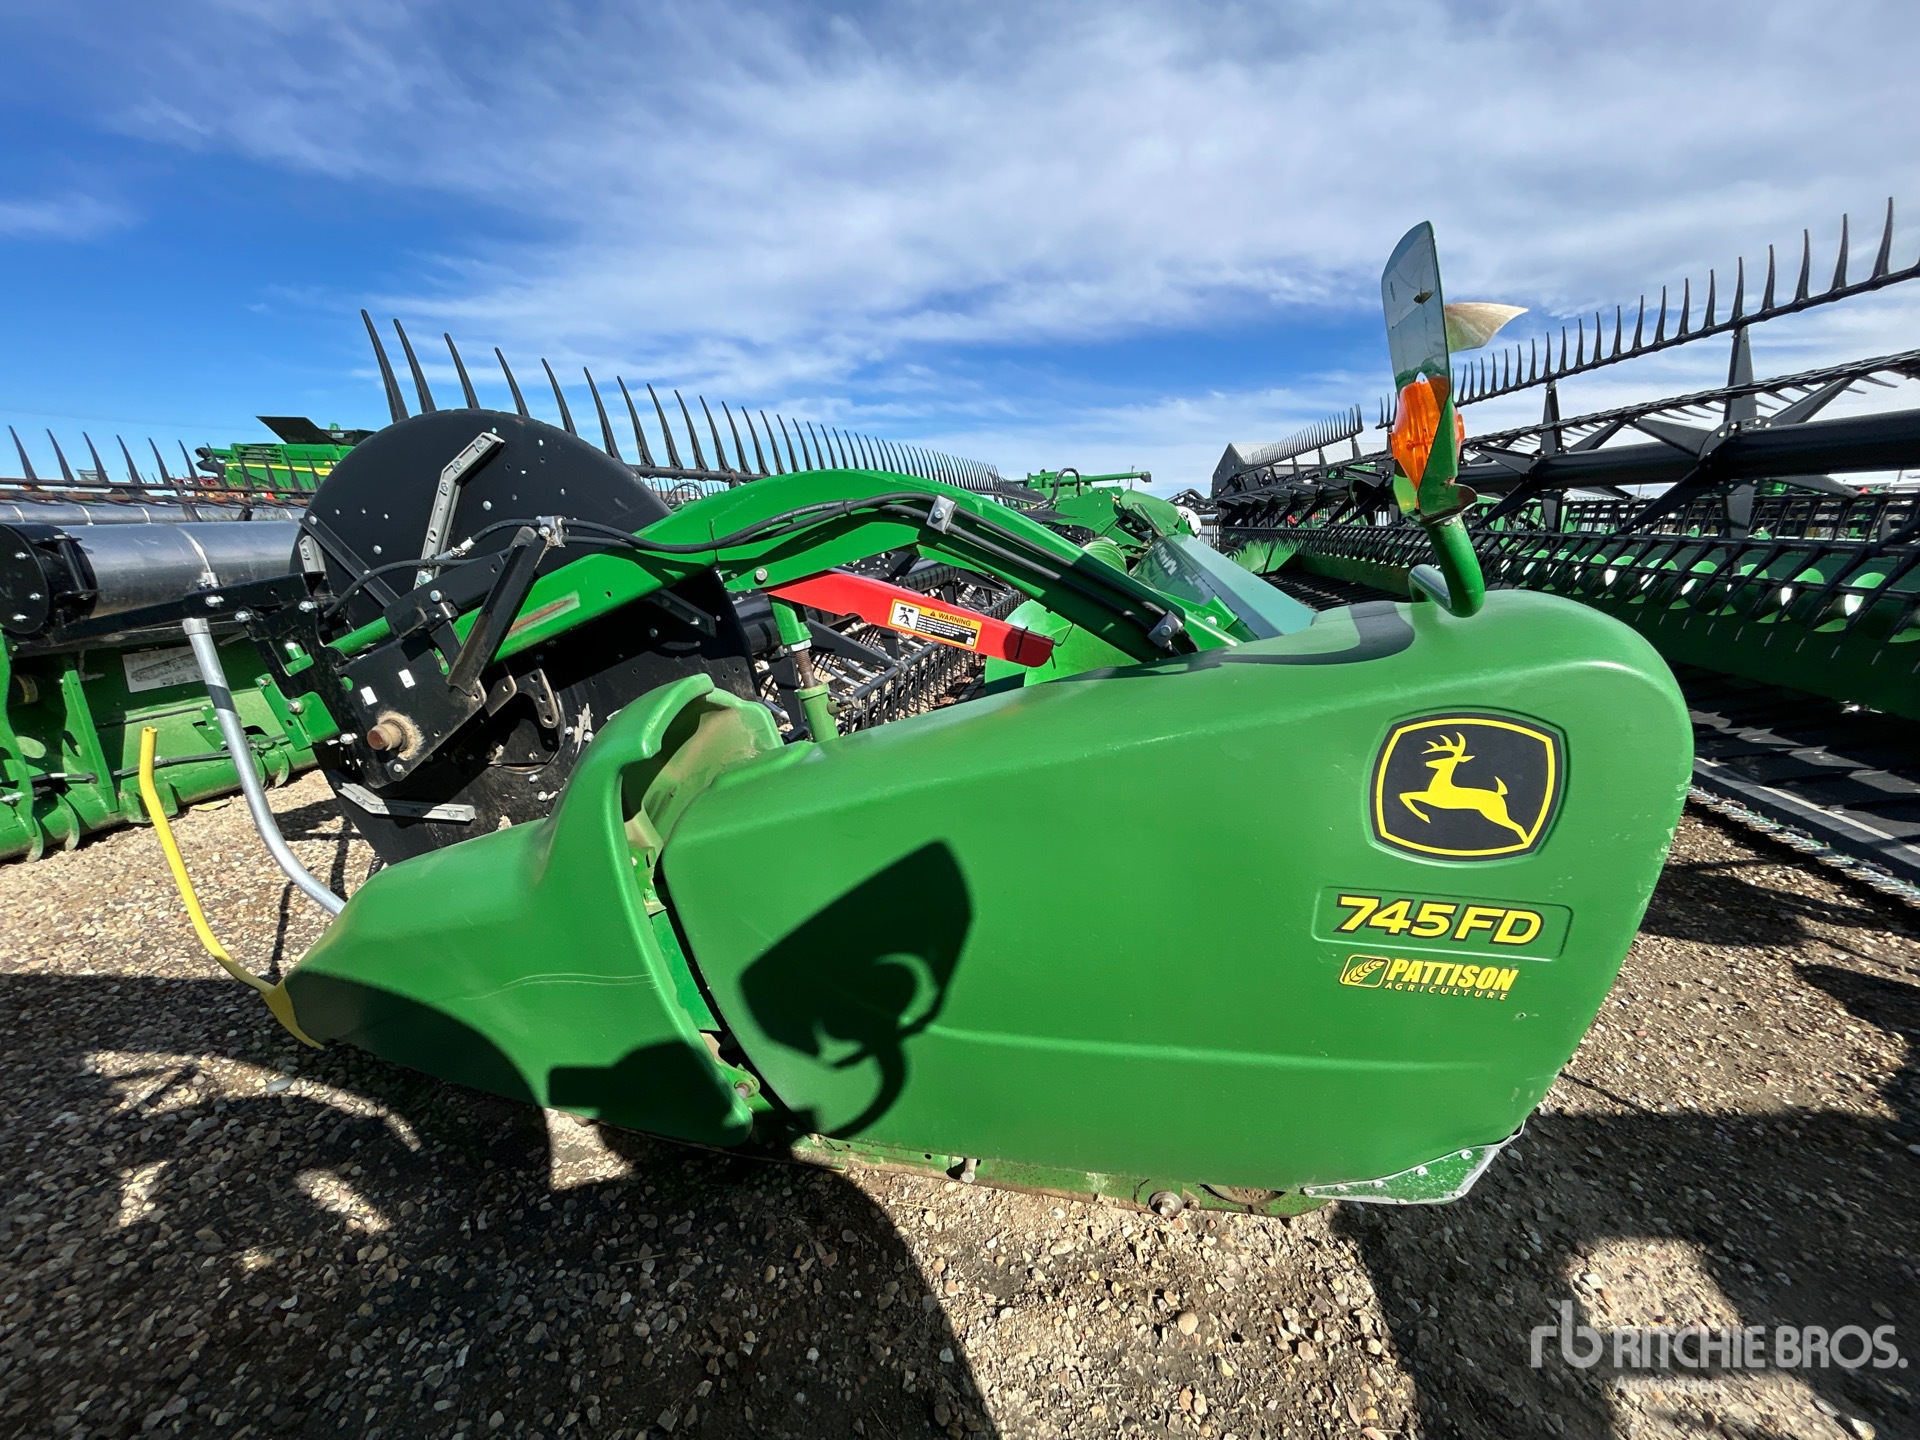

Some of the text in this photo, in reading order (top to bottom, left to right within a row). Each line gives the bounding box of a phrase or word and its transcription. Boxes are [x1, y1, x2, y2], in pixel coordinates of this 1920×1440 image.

[938, 613, 971, 626] WARNING
[1335, 895, 1544, 945] 745FD
[1387, 958, 1518, 991] PATTISON
[1385, 982, 1508, 1001] AGRICULTURE
